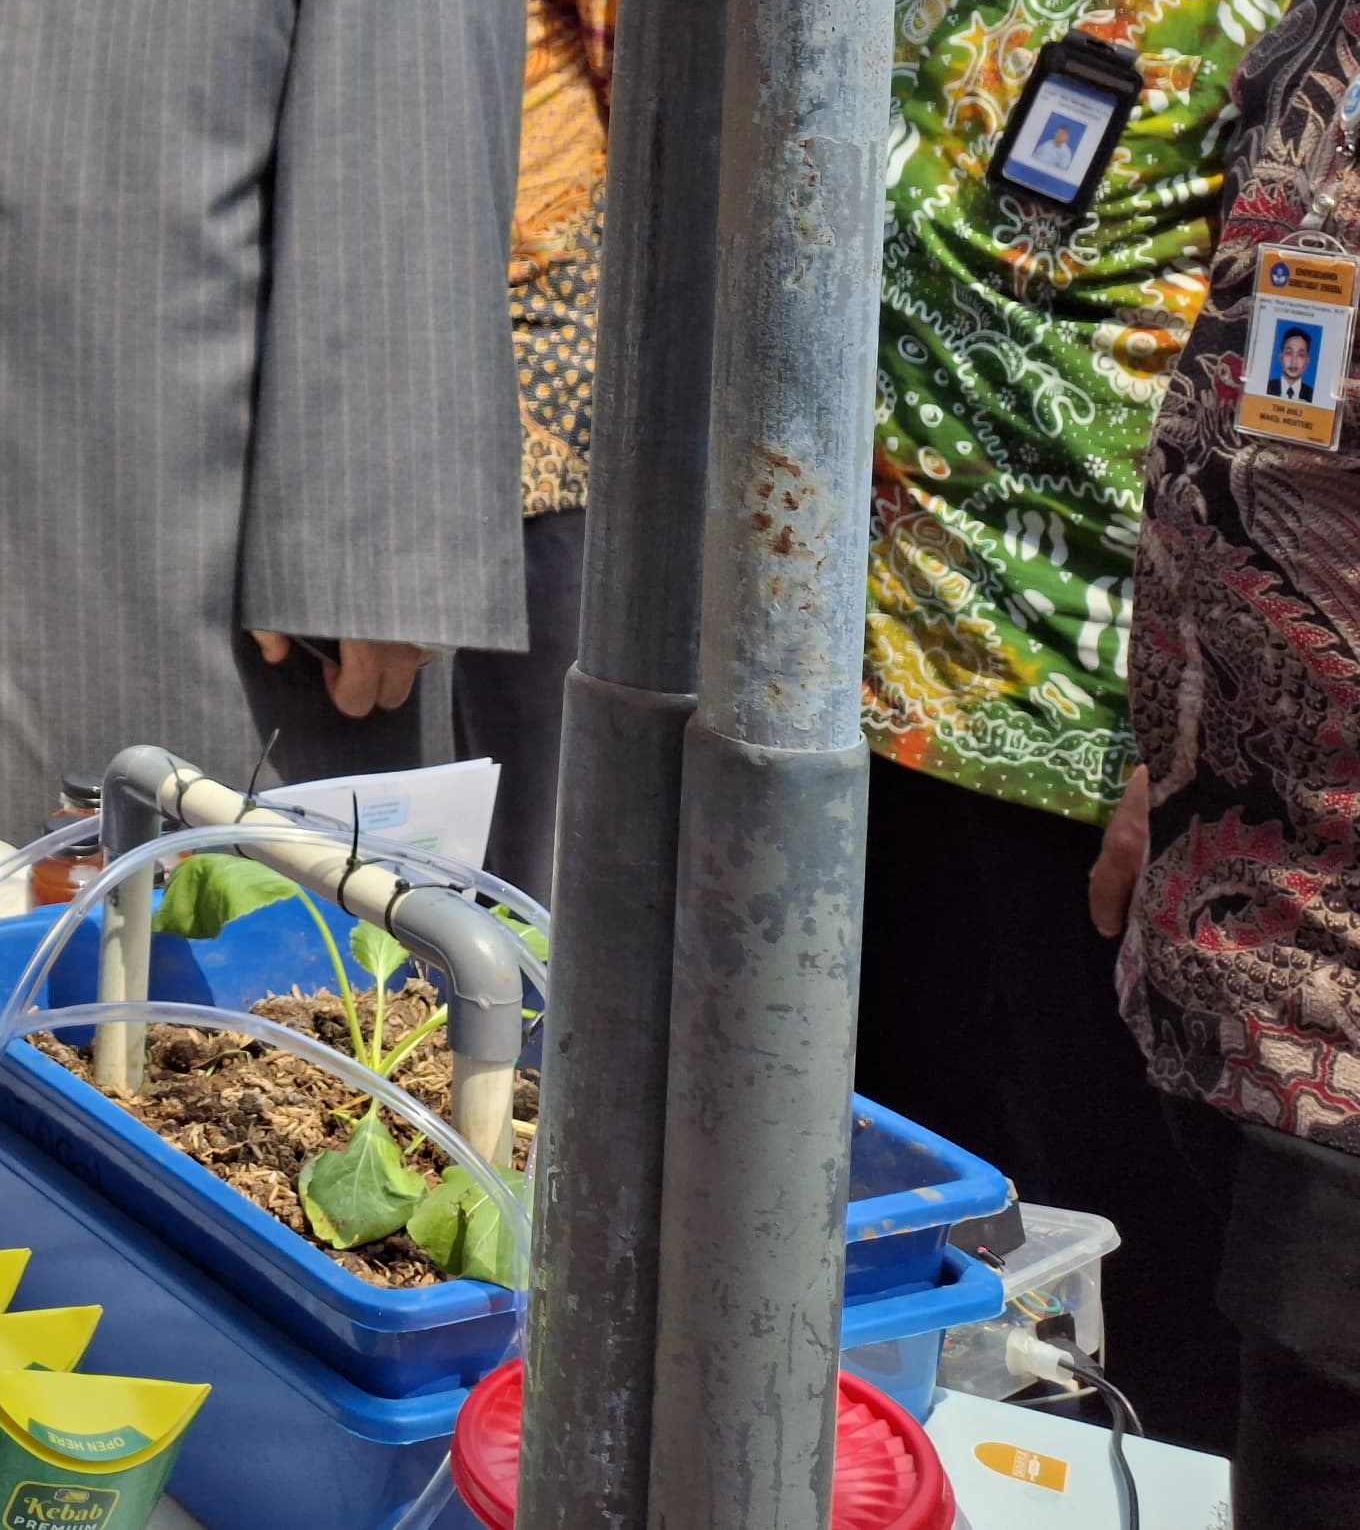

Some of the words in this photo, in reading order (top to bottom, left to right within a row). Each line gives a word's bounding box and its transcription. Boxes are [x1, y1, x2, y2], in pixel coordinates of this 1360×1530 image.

[47, 1430, 84, 1453] HERE
[86, 1435, 126, 1454] OPEN
[23, 1496, 104, 1523] Kebab
